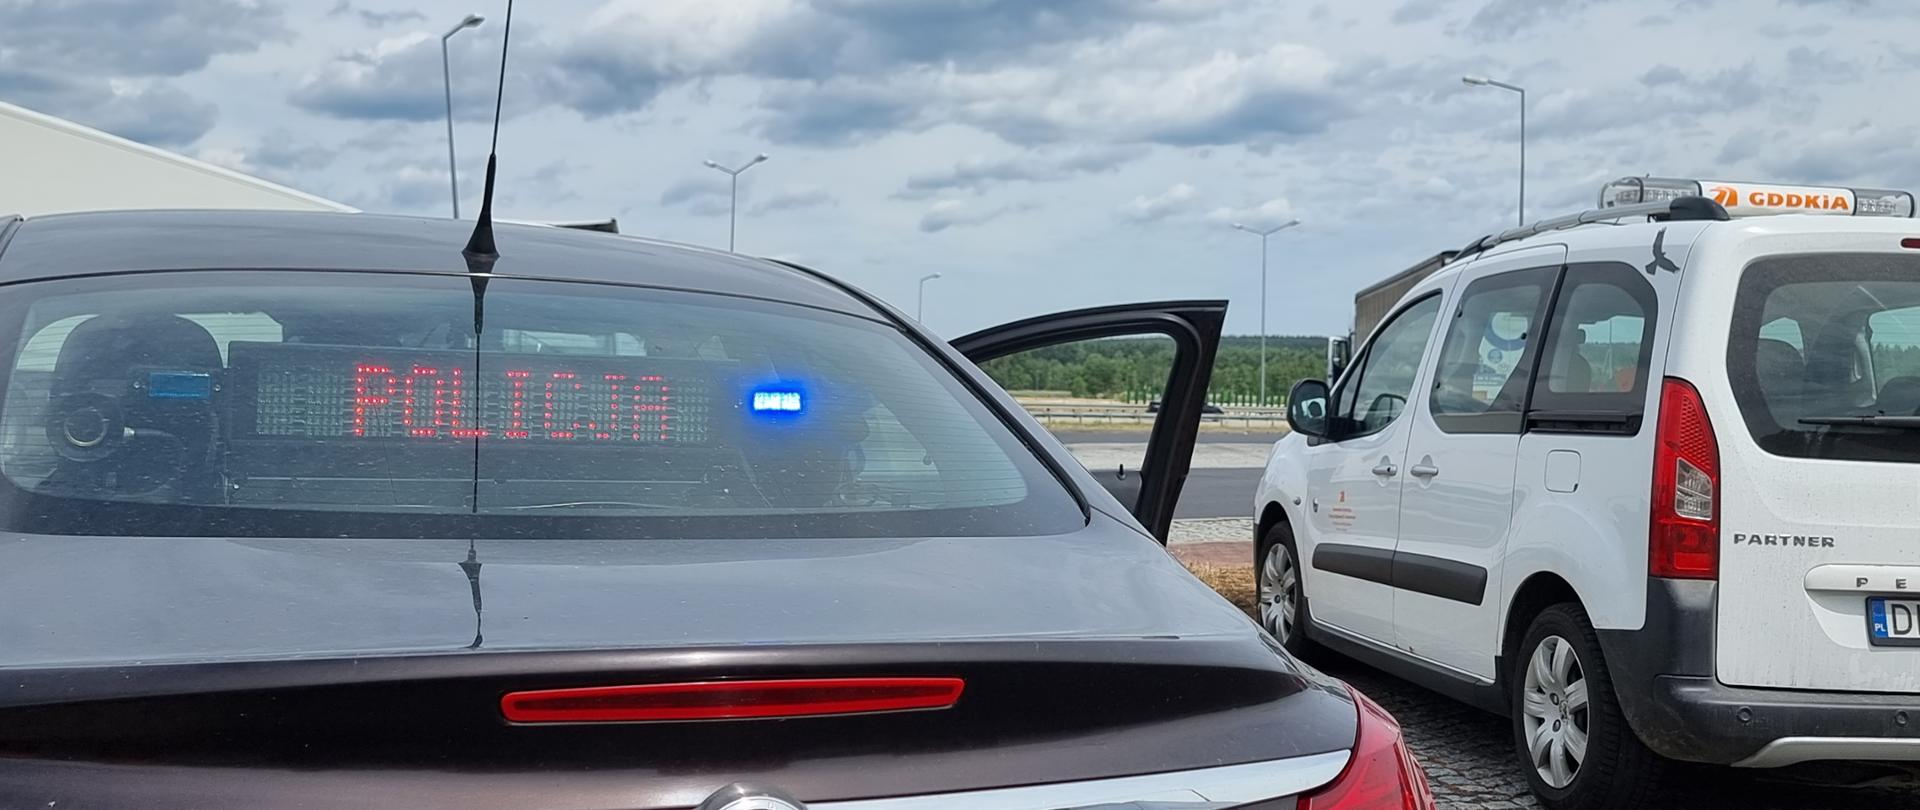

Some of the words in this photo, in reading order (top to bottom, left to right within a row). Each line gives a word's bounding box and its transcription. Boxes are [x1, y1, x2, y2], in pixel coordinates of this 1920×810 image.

[354, 366, 670, 440] POLICJA
[1733, 533, 1835, 548] PARTNER
[1874, 623, 1887, 632] PL
[1891, 603, 1920, 636] D
